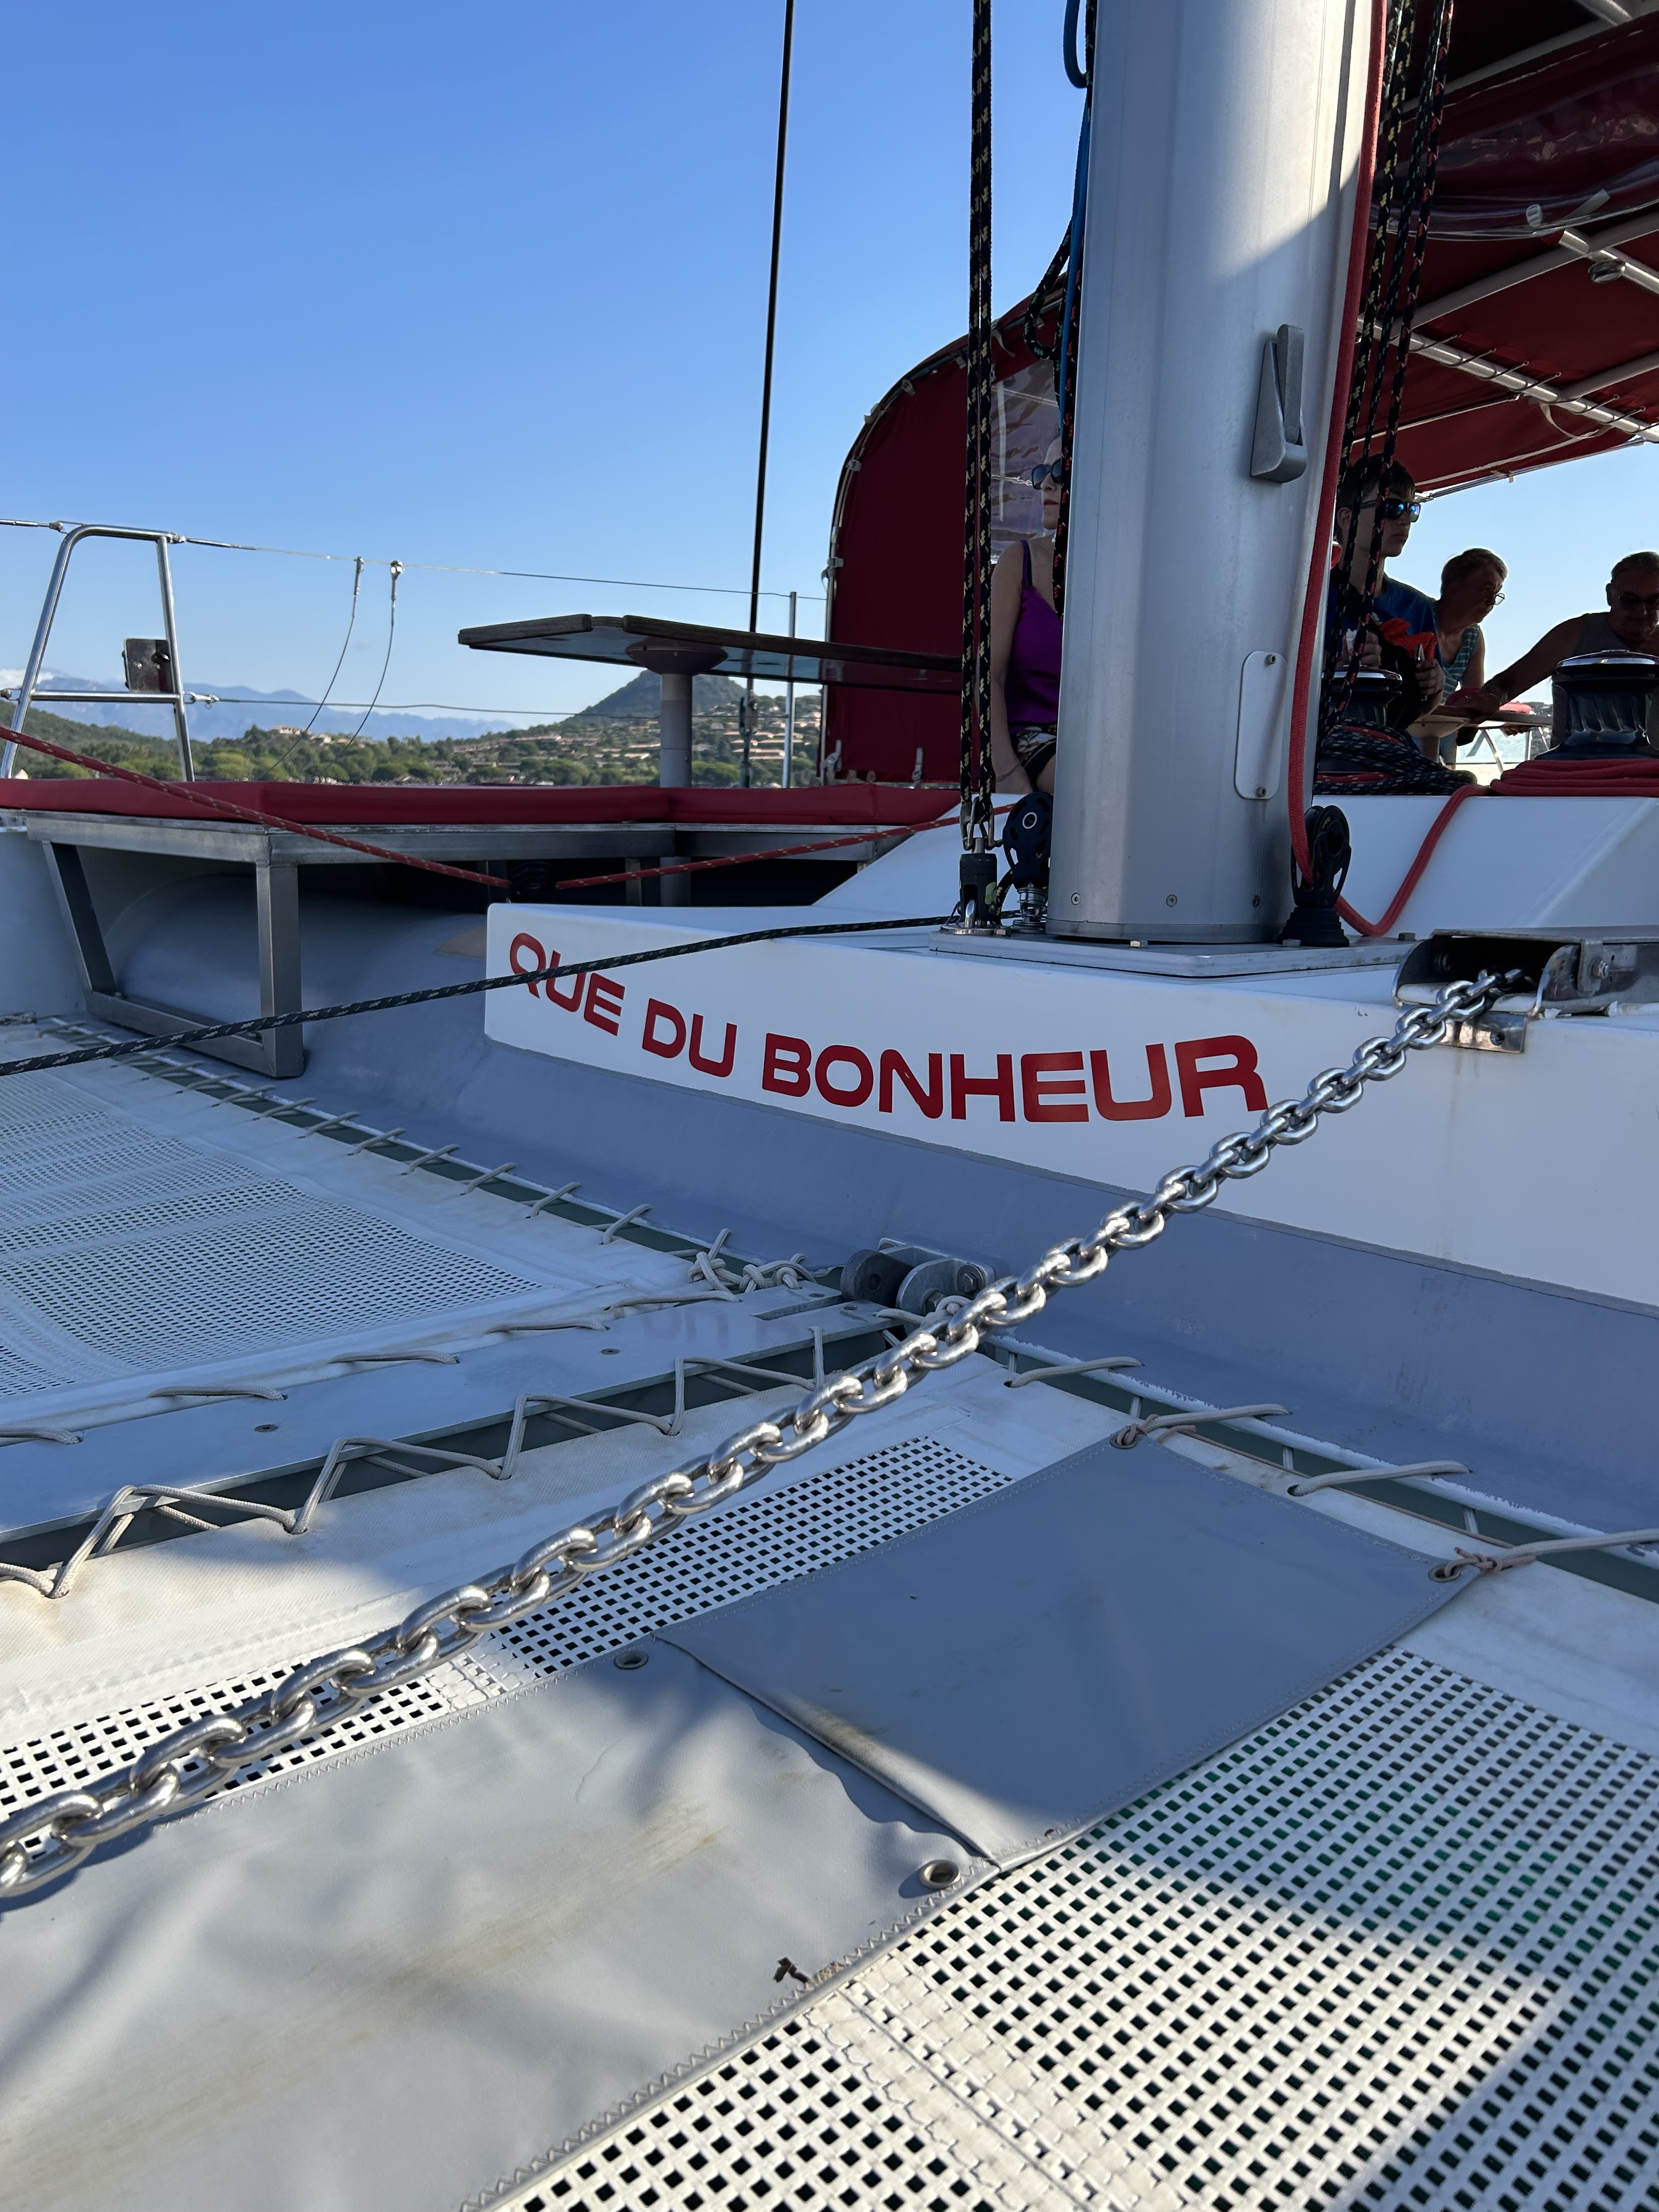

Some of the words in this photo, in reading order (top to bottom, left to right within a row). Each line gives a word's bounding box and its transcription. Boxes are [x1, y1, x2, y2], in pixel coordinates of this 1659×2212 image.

[510, 932, 625, 1036] QUE
[642, 998, 738, 1077] DU
[761, 1032, 1269, 1122] BONHEUR
